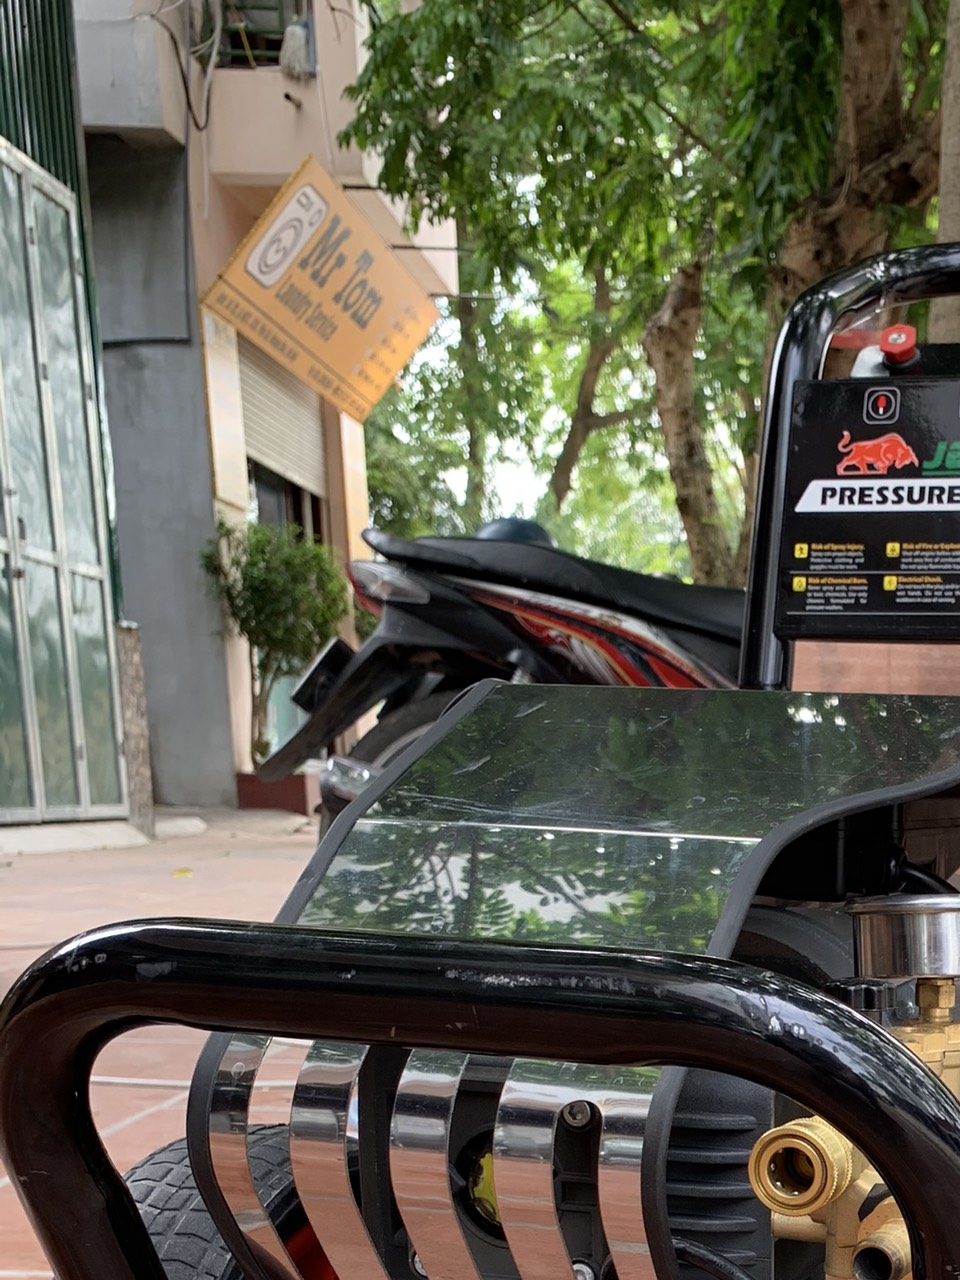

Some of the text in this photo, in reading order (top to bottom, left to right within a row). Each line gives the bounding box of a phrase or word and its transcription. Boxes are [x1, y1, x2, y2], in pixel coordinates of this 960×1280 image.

[275, 275, 313, 322] Laundry
[305, 298, 338, 343] Service
[298, 214, 351, 288] Mr
[332, 249, 383, 330] Tom
